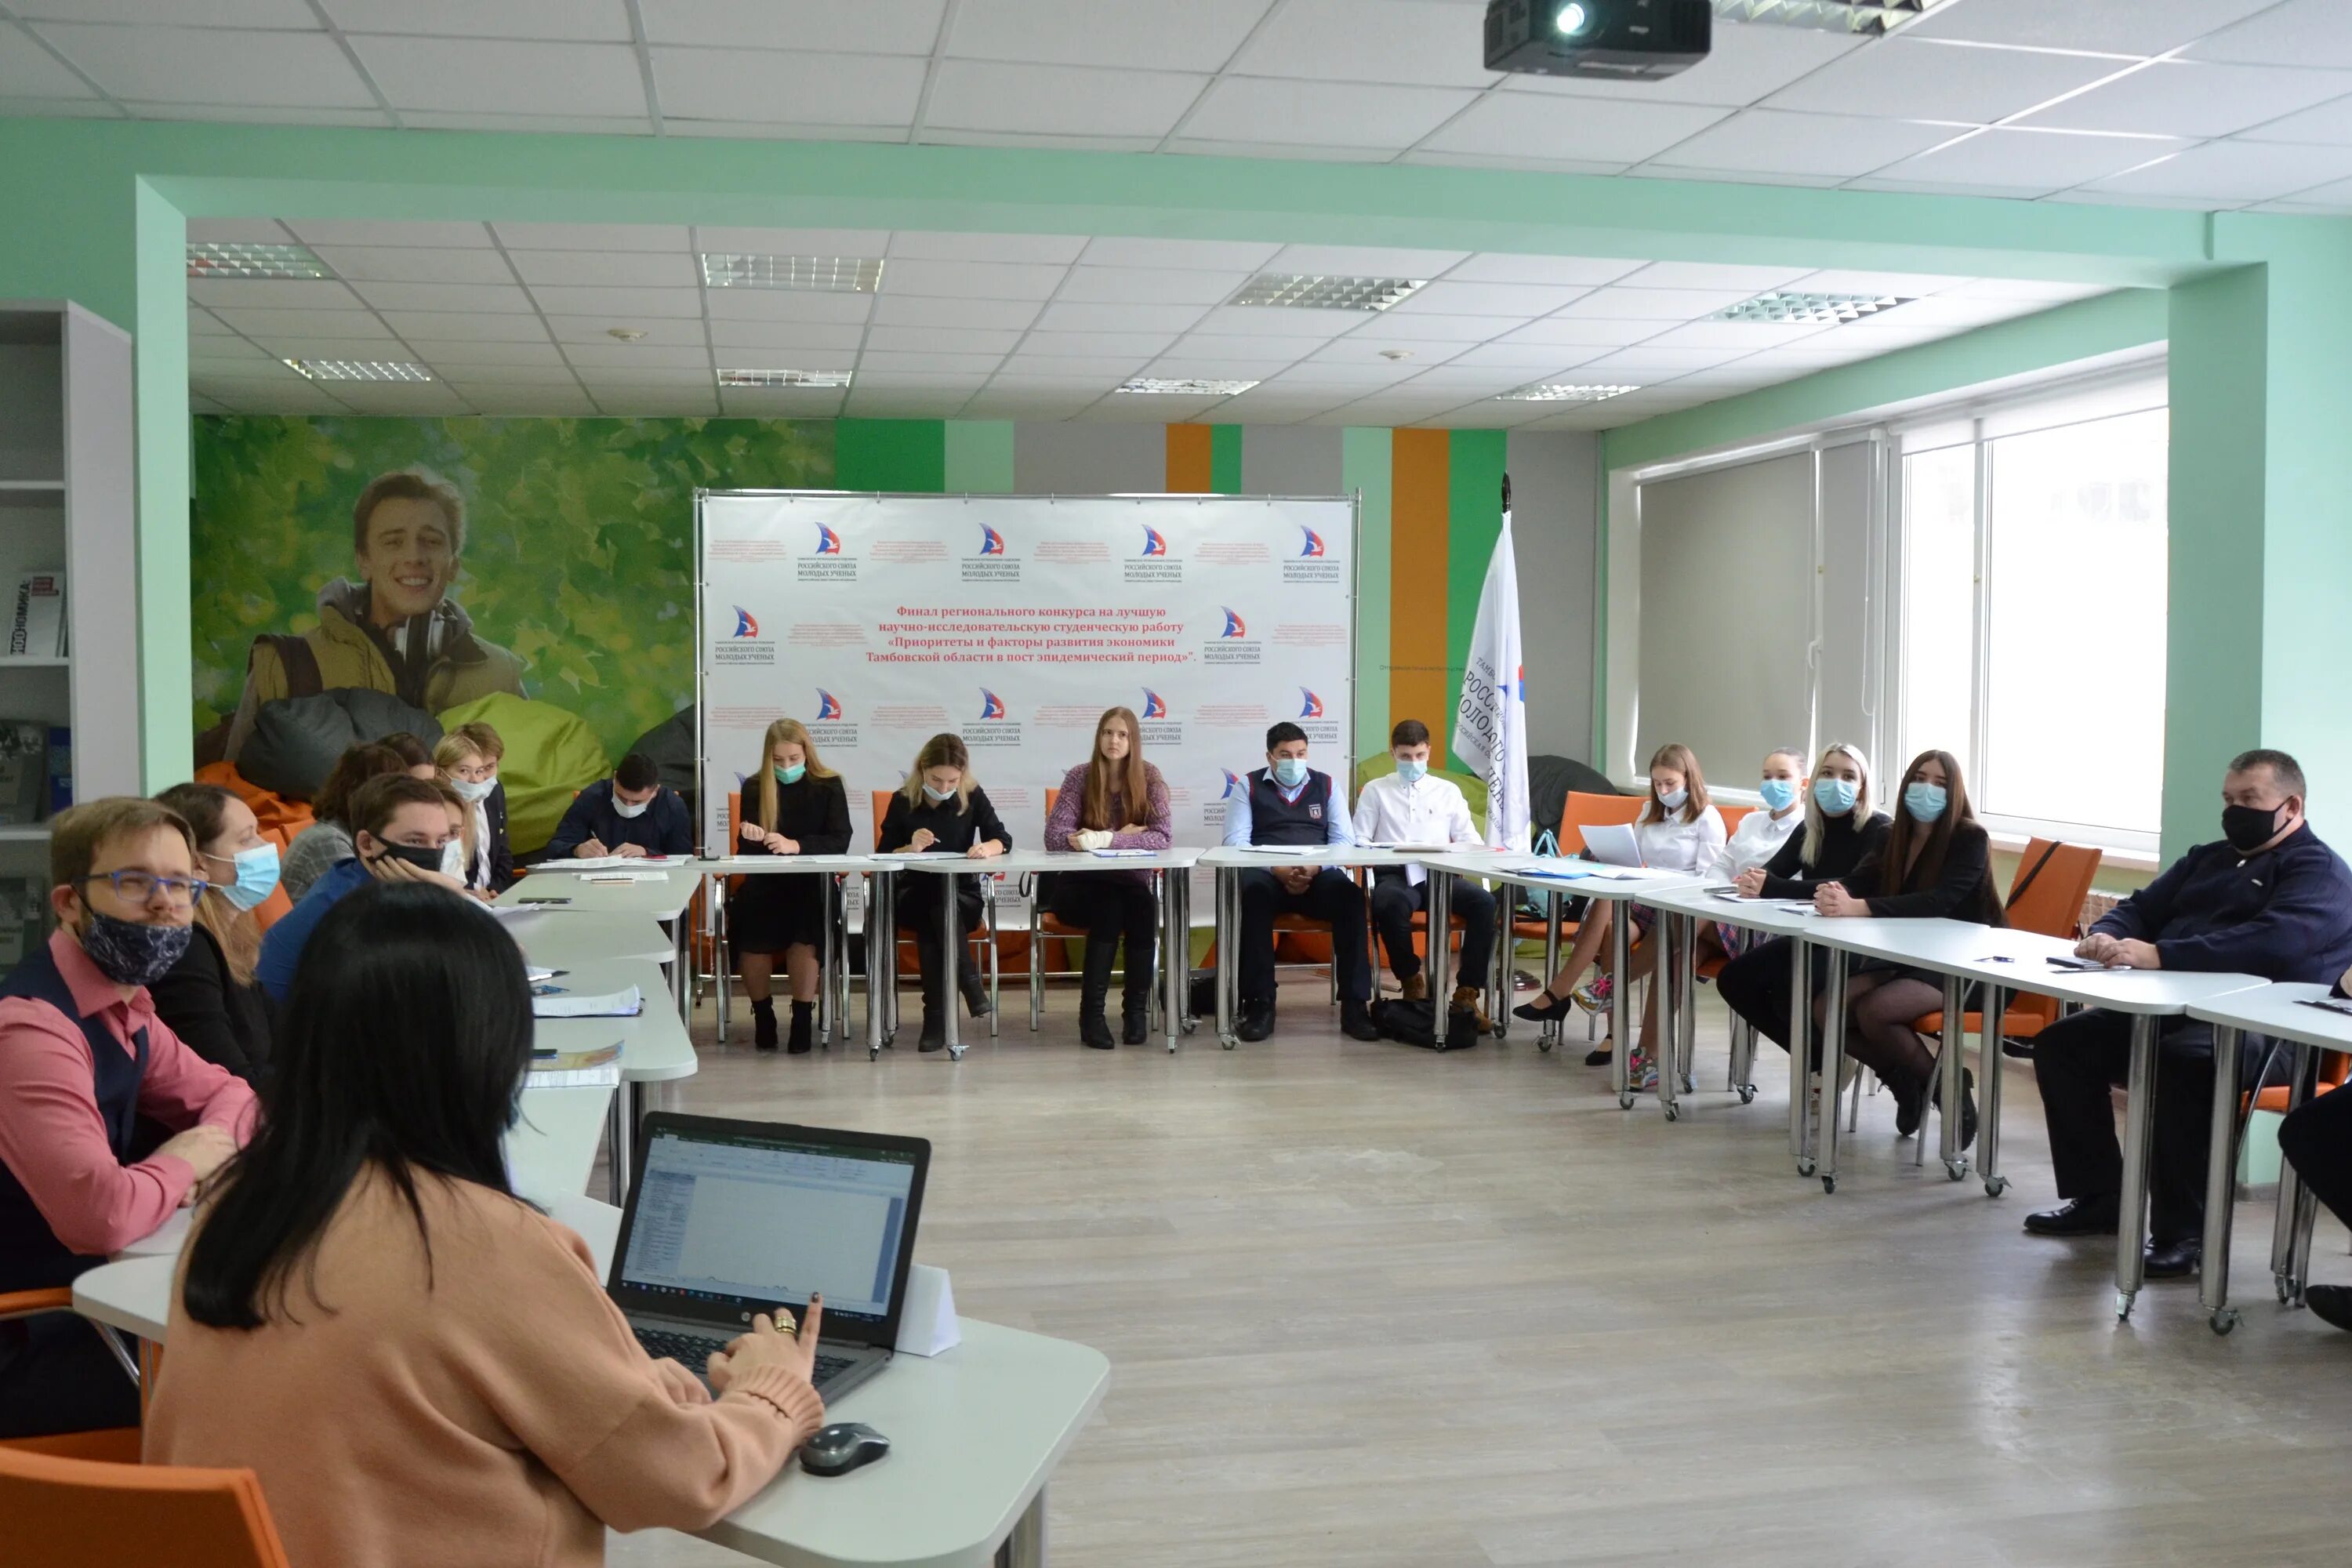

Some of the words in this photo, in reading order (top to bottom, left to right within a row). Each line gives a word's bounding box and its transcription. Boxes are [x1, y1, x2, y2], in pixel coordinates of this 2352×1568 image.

[897, 606, 938, 616] Финал
[941, 608, 1035, 619] регионального
[1038, 608, 1095, 619] конкурса
[1116, 608, 1166, 619] лучшую
[879, 624, 1051, 633] научно-исследовательскую
[1053, 624, 1138, 633] студенческую
[1142, 622, 1184, 634] работу
[888, 637, 973, 649] «Приоритеты
[987, 637, 1043, 649] факторы
[1046, 639, 1104, 649] развития
[866, 652, 940, 662] Тамбовской
[943, 652, 993, 662] области
[1036, 652, 1134, 663] эпидемический
